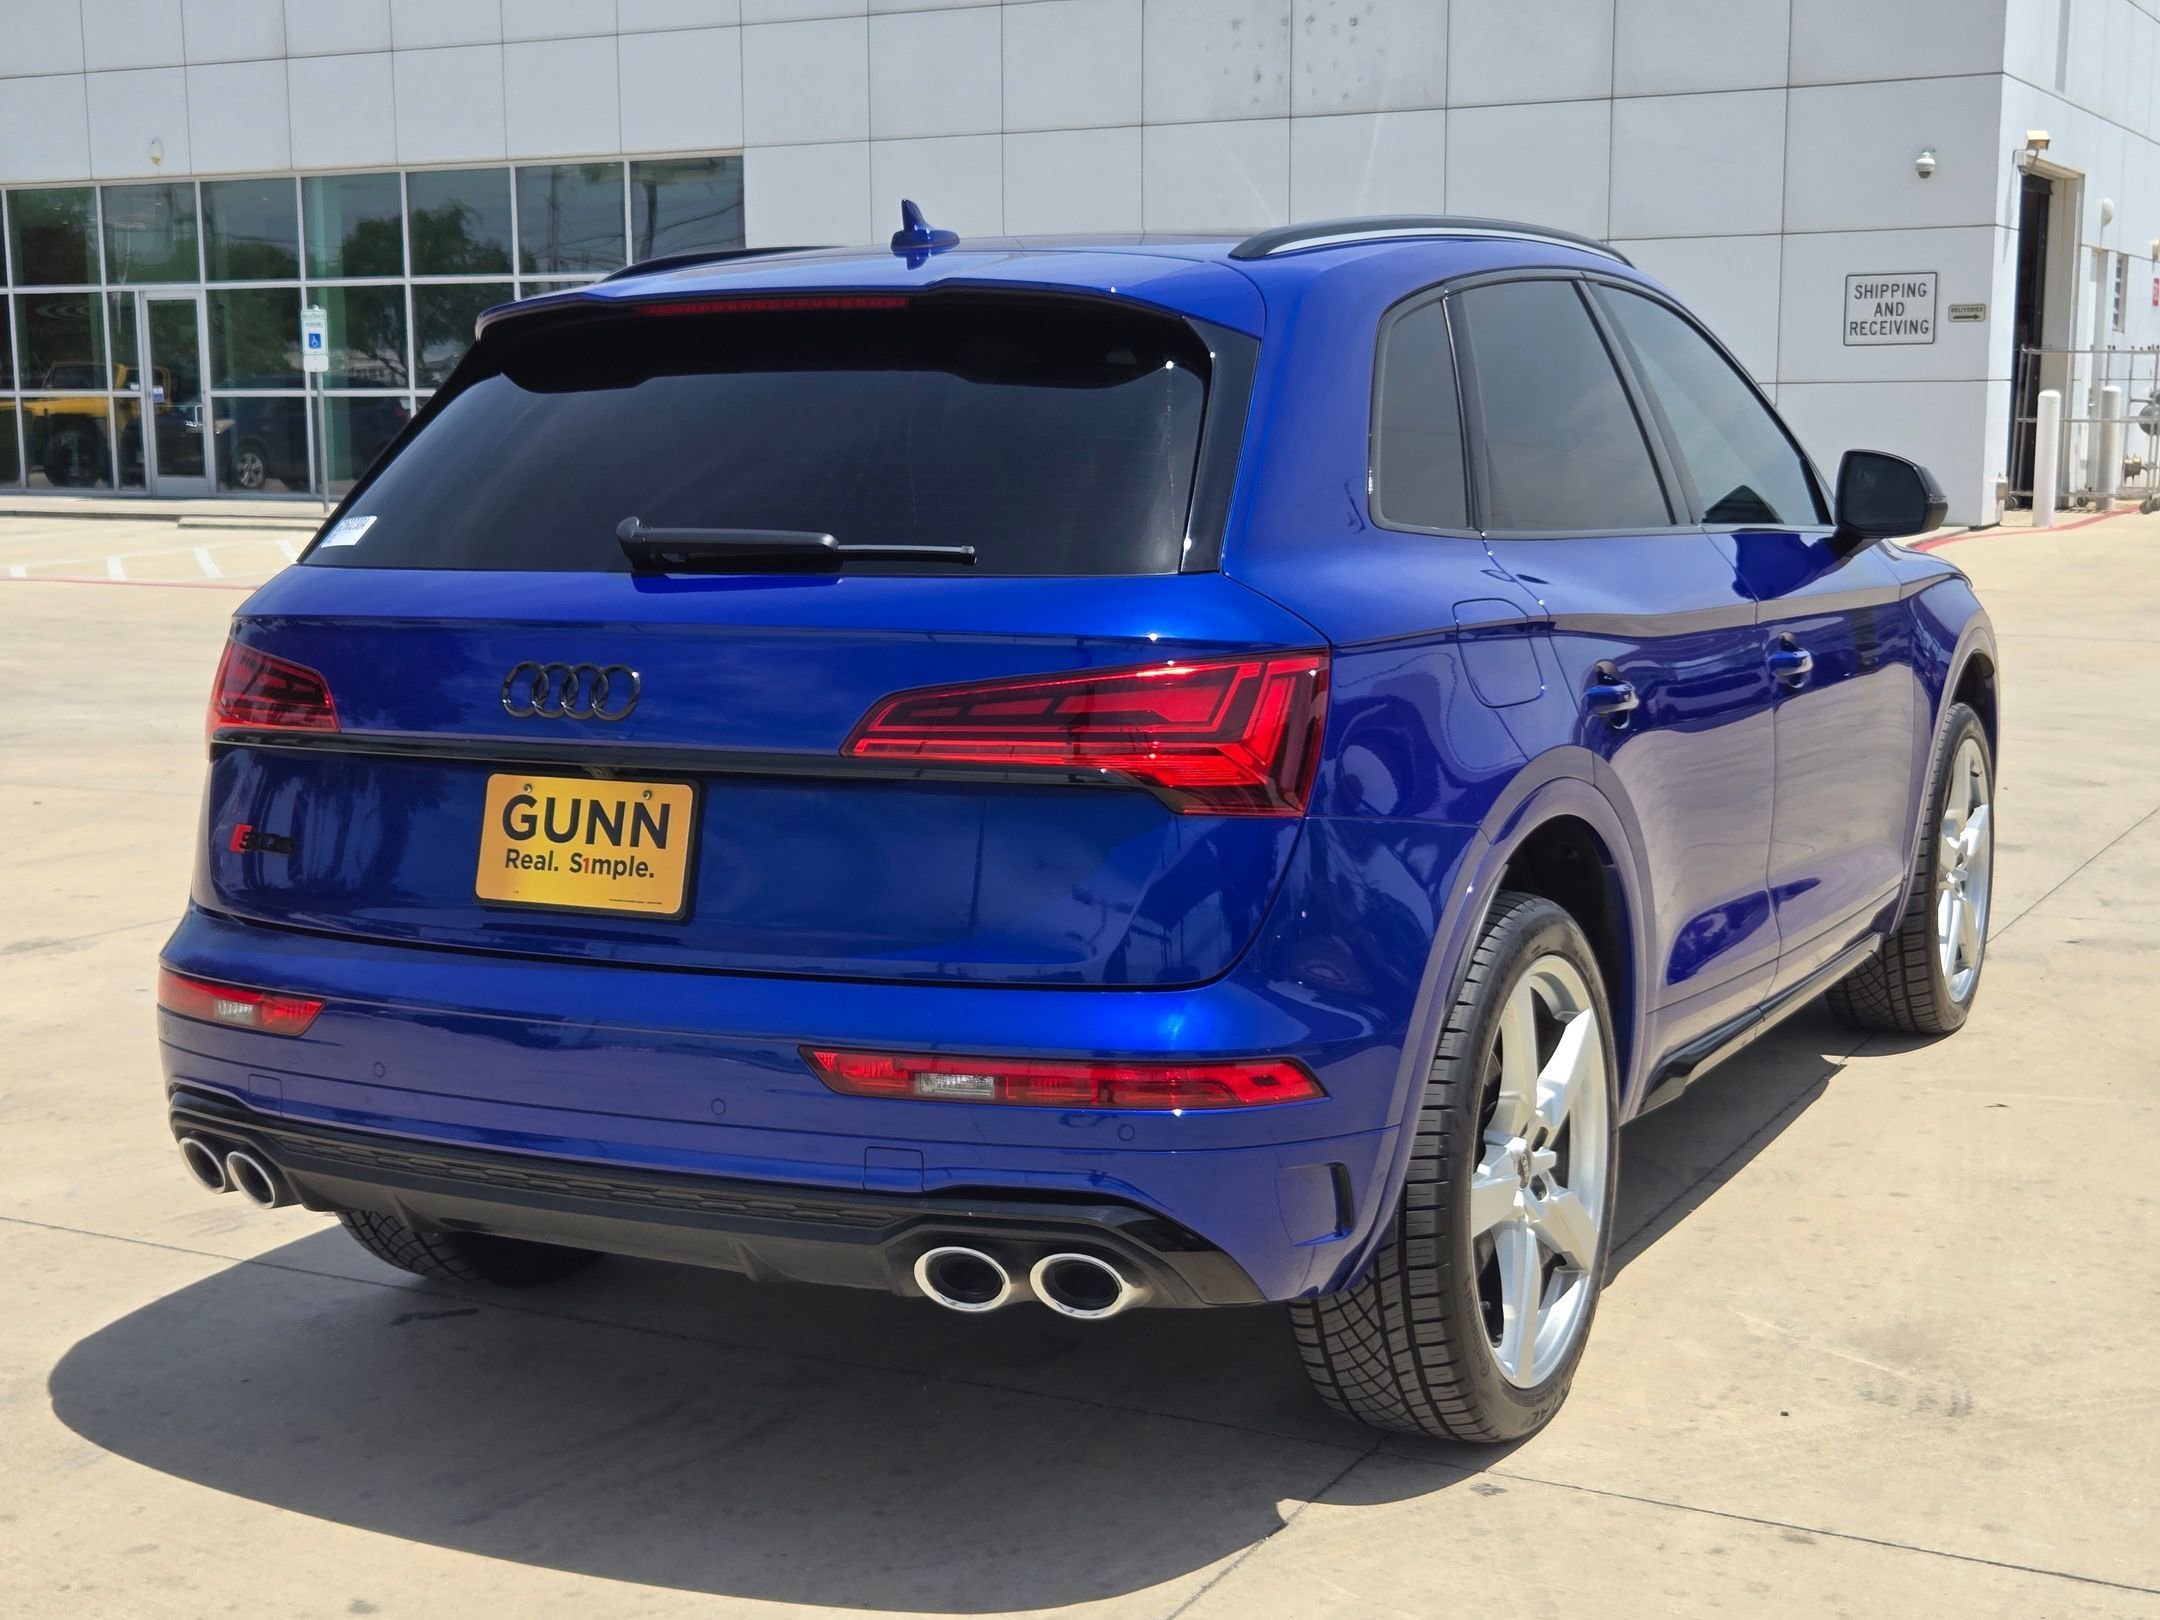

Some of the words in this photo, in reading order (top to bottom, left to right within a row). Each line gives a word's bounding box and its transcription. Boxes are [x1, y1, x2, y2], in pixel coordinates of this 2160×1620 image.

[1854, 282, 1927, 300] SHIPPING
[1873, 301, 1905, 317] AND
[1849, 319, 1929, 336] RECEIVING
[502, 794, 670, 849] GUNN
[505, 848, 559, 872] Real.
